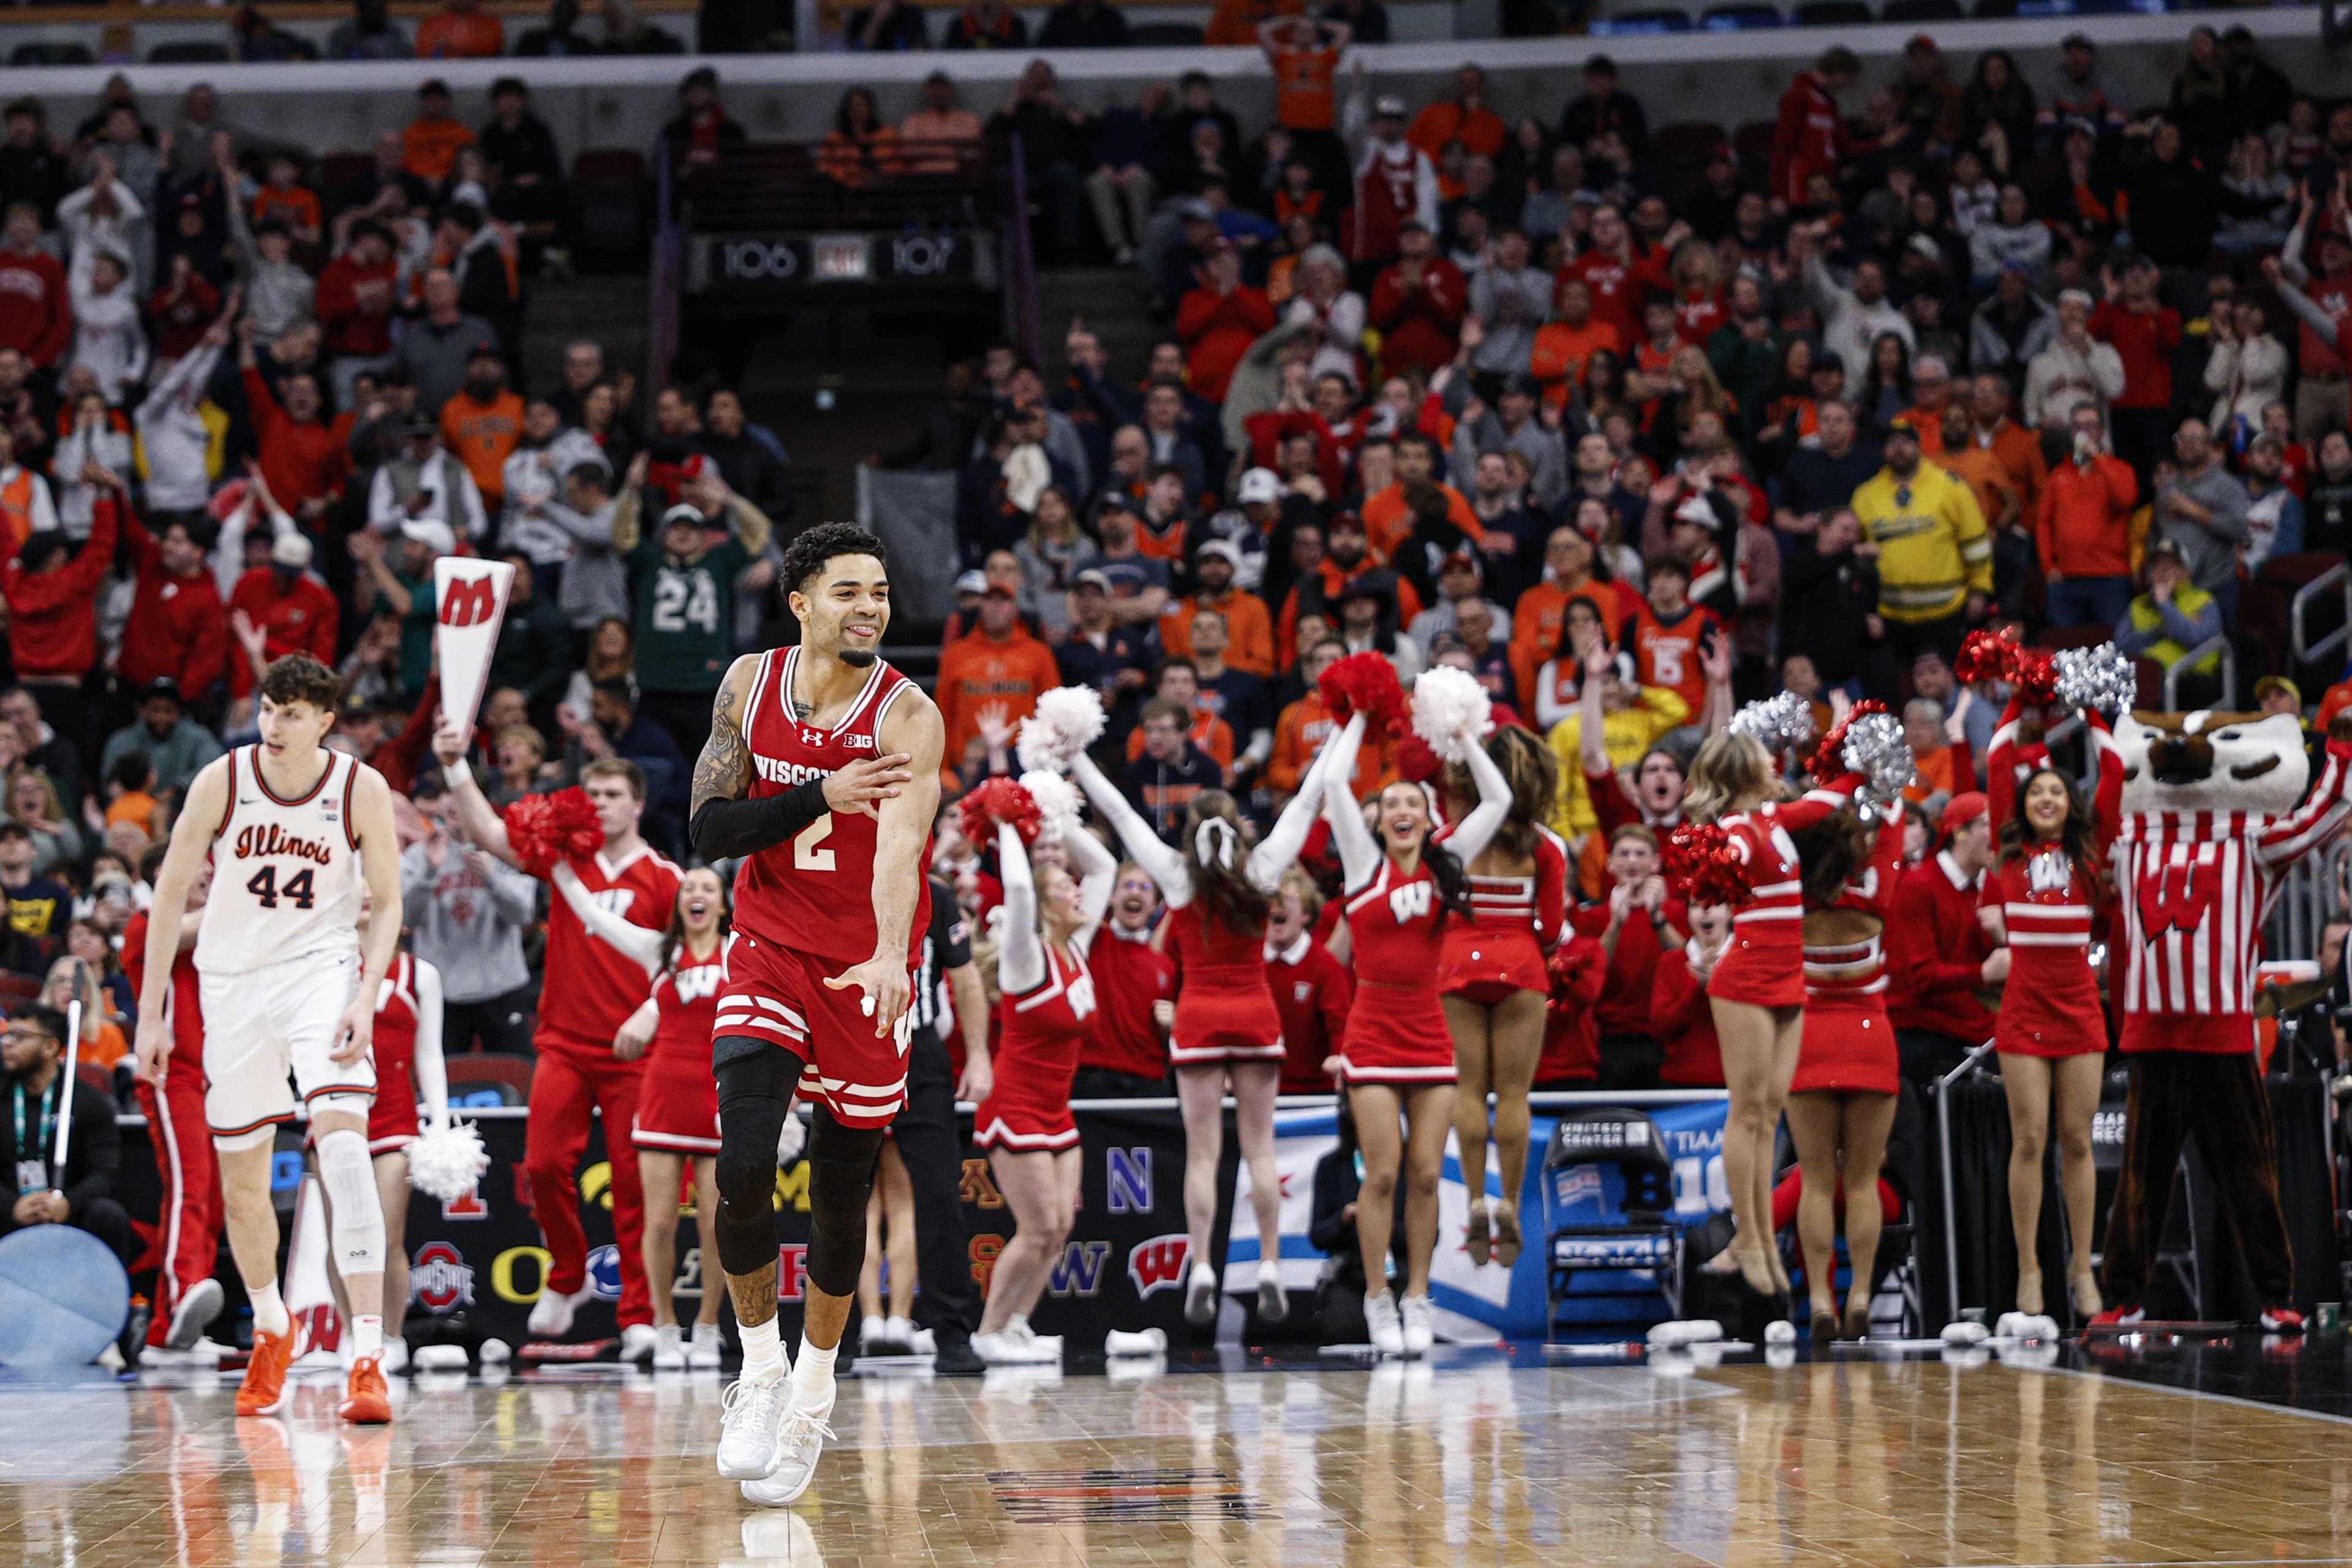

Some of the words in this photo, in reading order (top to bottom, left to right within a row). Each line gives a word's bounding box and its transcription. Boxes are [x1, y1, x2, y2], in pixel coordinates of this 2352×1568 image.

[725, 239, 797, 278] 106
[893, 237, 954, 275] 107
[652, 567, 718, 633] 24
[235, 821, 331, 865] Illinois
[794, 810, 837, 871] 2
[246, 865, 314, 909] 44
[1389, 880, 1432, 927] W
[2137, 859, 2212, 947] W
[676, 964, 722, 1005] W
[1561, 1122, 1623, 1134] UNITED
[1562, 1134, 1624, 1147] CENTER
[1107, 1147, 1153, 1215] N
[491, 1245, 552, 1305] O
[1049, 1241, 1112, 1297] W
[1128, 1233, 1194, 1302] W
